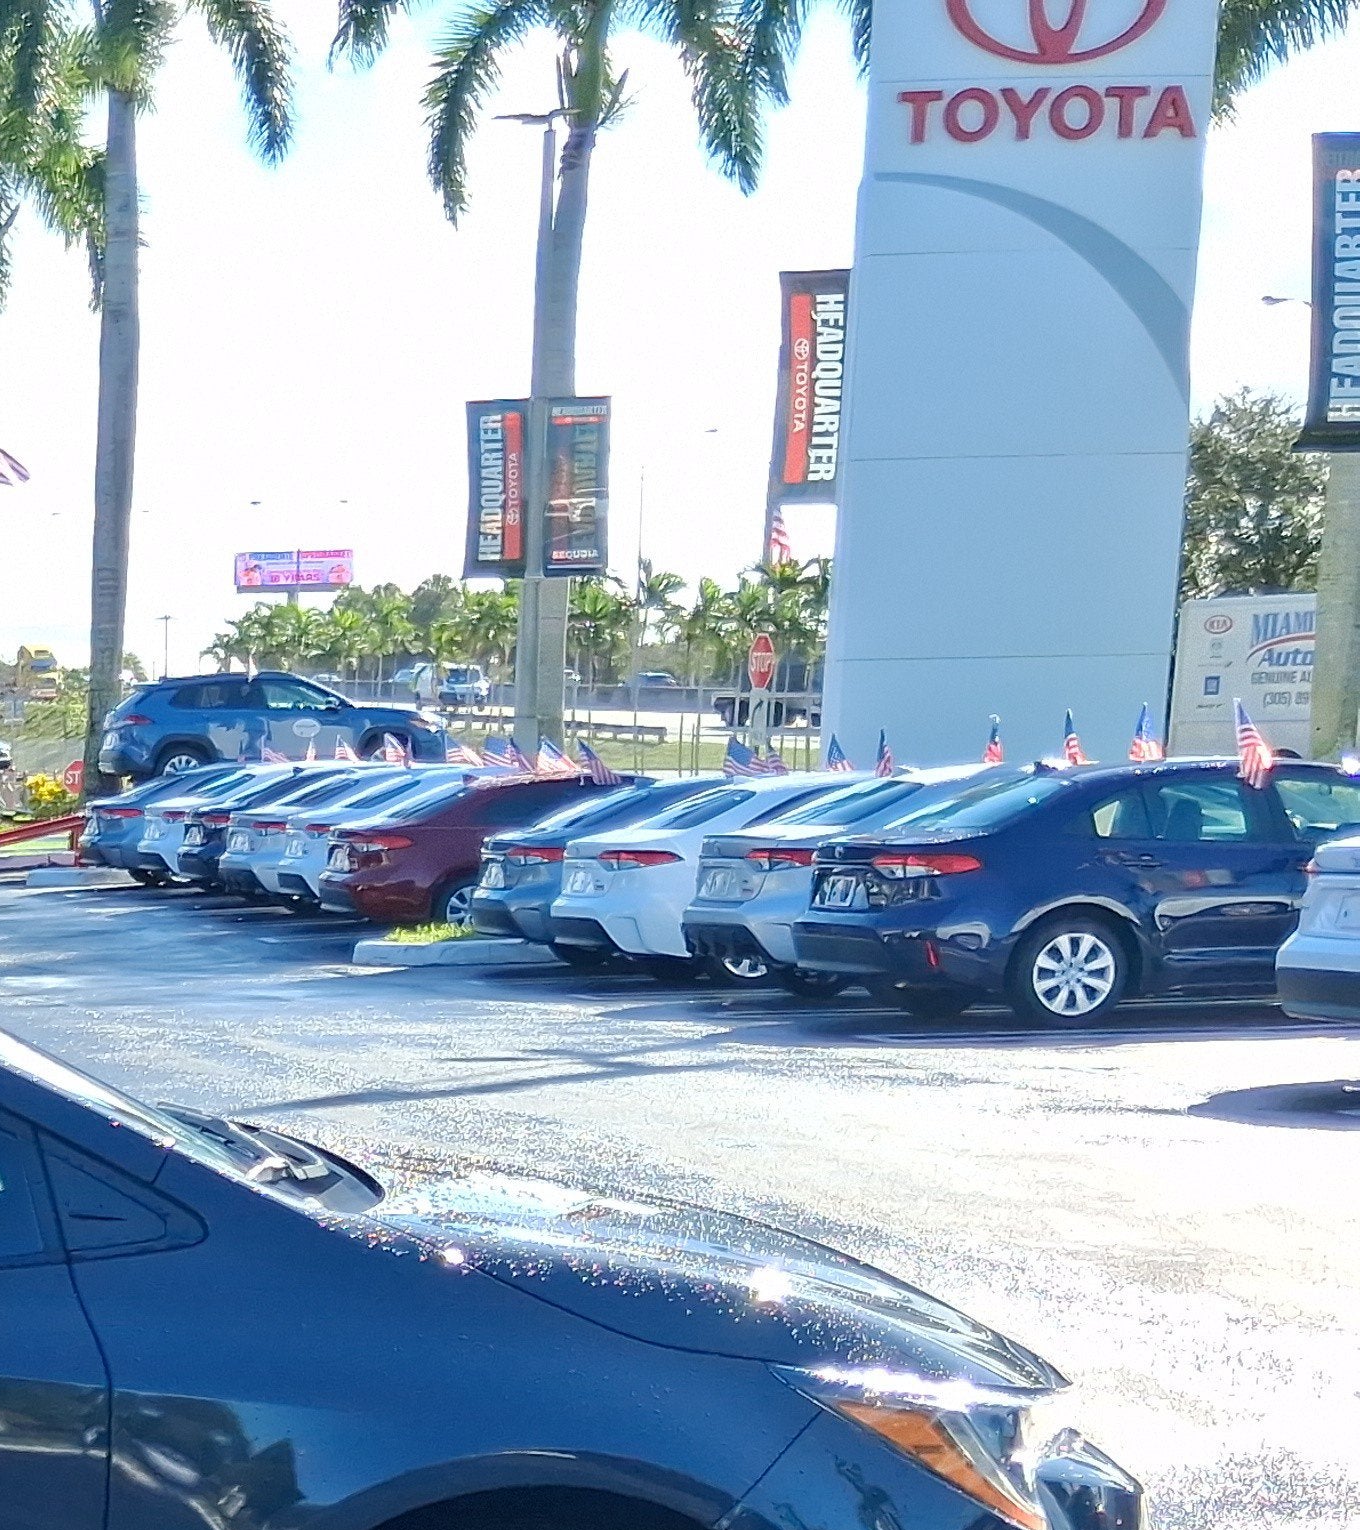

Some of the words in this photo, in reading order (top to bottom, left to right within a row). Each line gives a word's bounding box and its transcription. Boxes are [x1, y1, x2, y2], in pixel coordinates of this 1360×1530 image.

[897, 84, 1197, 144] TOYOTA
[792, 362, 809, 433] TOYOTA
[807, 293, 845, 482] HEADQUARTER
[478, 414, 505, 561] HEADQUARTER
[508, 453, 519, 507] TOYOTA
[1251, 610, 1315, 649] MIAM
[751, 652, 772, 672] STOP
